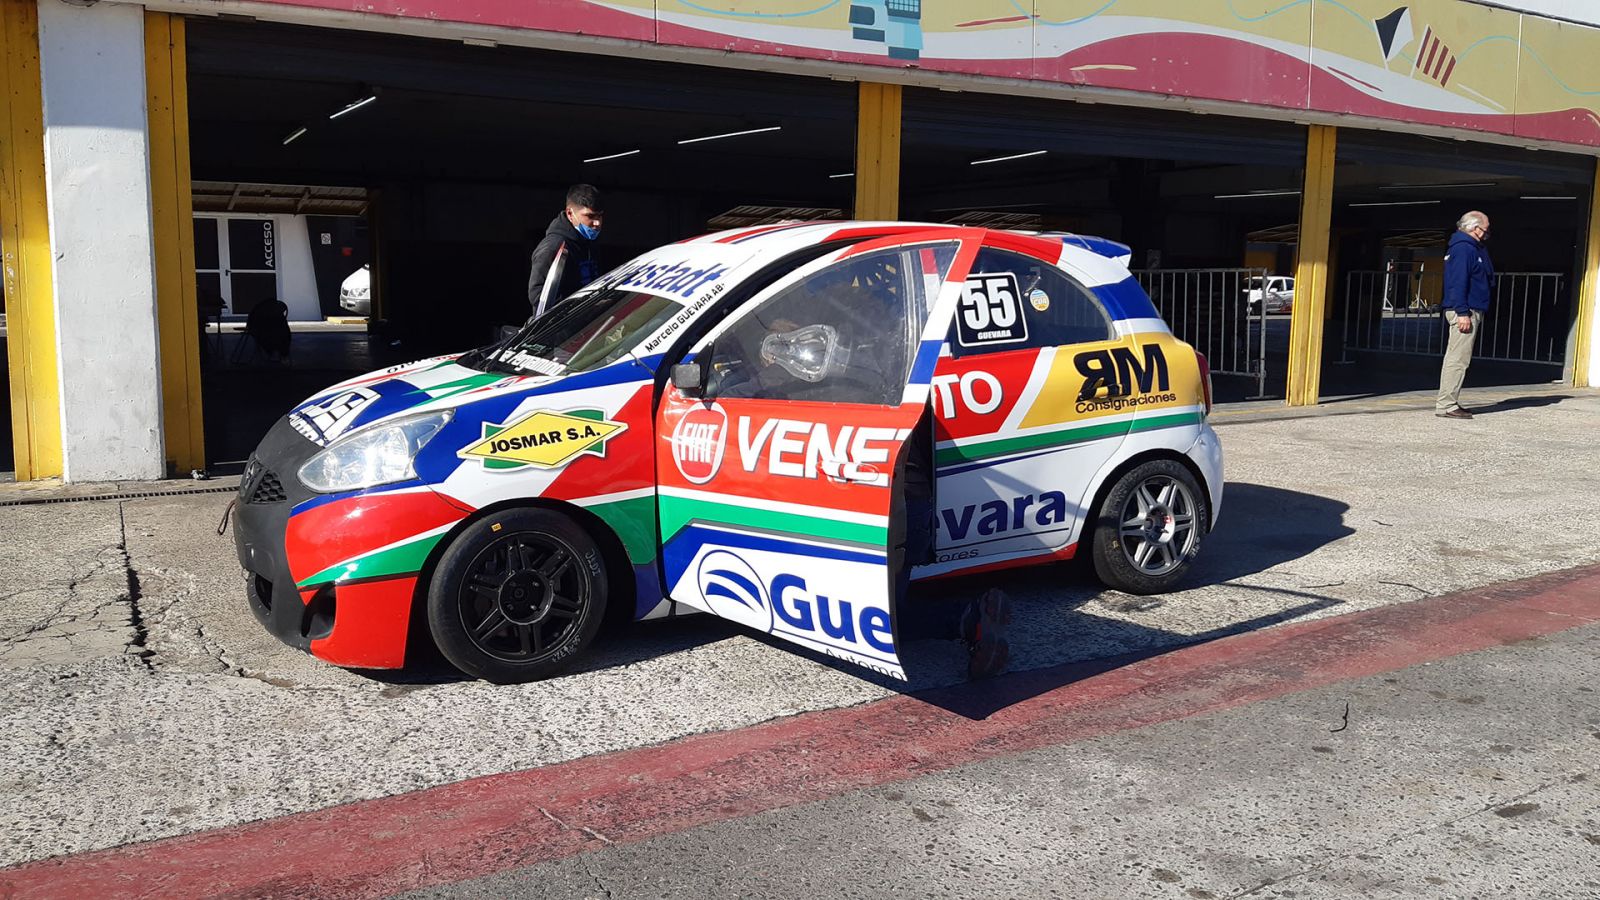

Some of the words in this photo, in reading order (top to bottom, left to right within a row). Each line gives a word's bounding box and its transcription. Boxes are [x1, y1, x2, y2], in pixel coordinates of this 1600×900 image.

[263, 221, 274, 268] ACCESO
[644, 321, 680, 353] Marcelo
[677, 293, 713, 326] GUEVARA
[962, 277, 1017, 330] 55
[977, 329, 1012, 340] GUEVARA
[931, 370, 1003, 419] TO
[1075, 392, 1177, 414] Consignaciones
[490, 429, 562, 454] JOSMAR
[566, 424, 601, 441] S.A.
[680, 422, 719, 464] FIAT
[937, 547, 979, 564] ores
